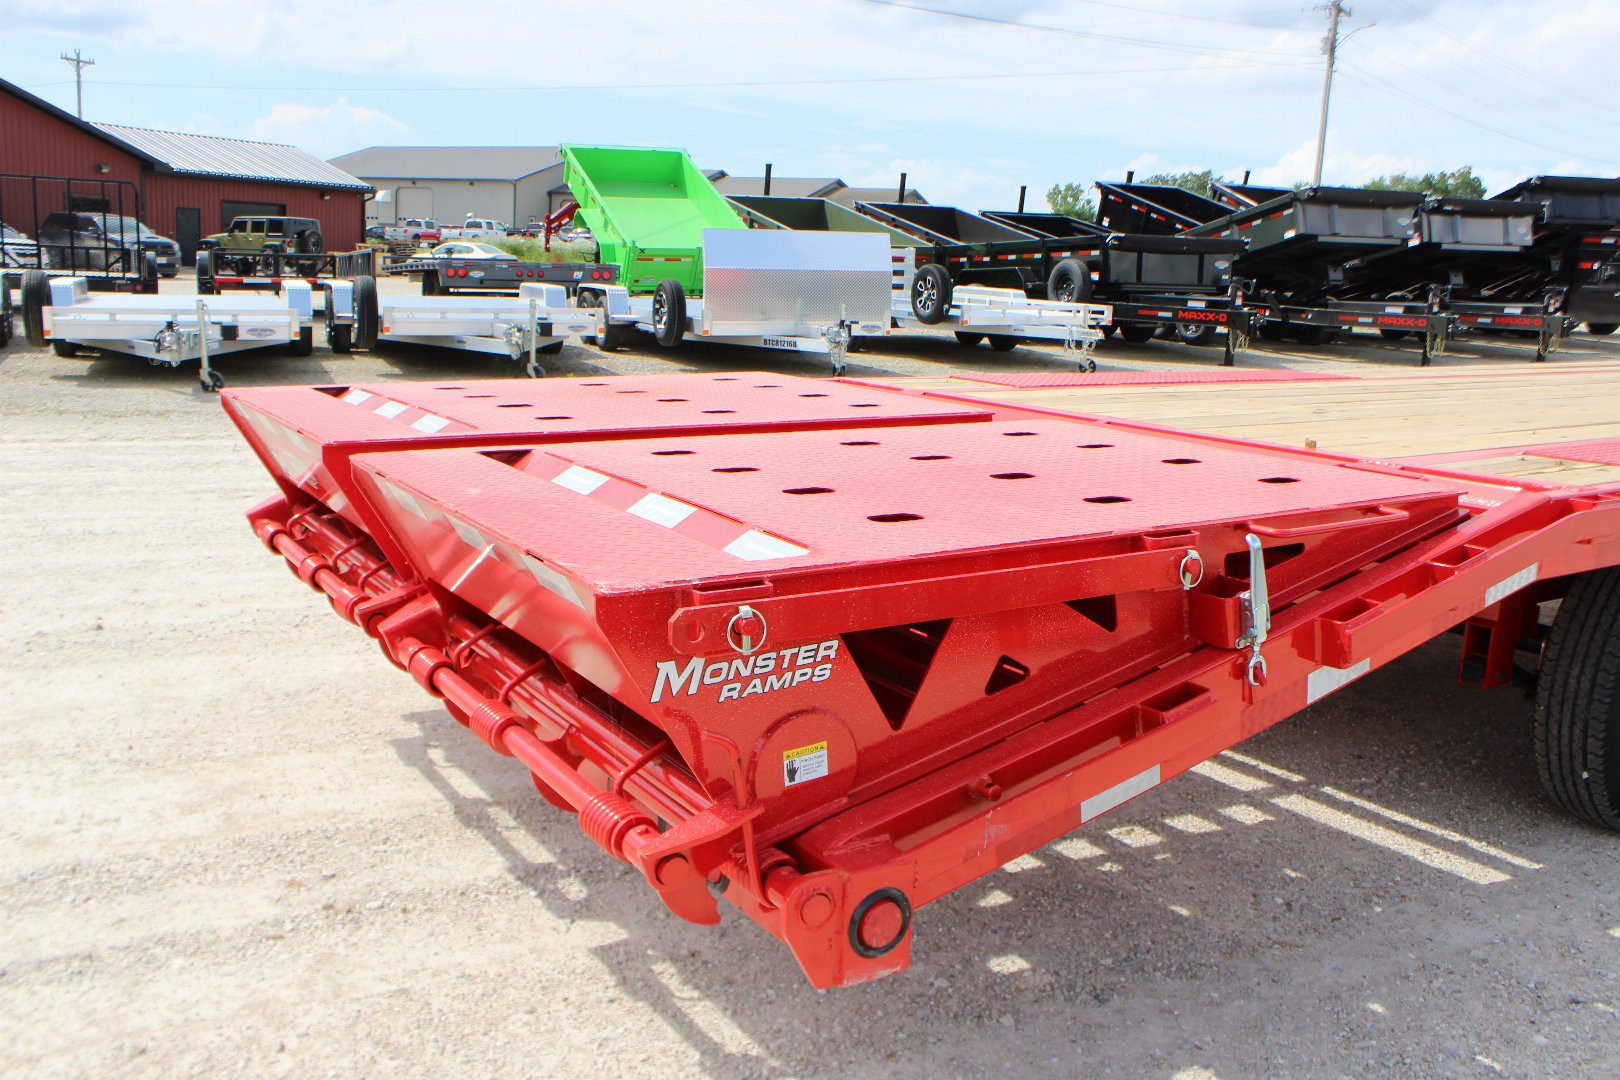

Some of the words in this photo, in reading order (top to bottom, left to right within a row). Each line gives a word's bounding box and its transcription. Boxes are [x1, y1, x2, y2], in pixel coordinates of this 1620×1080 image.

[1178, 310, 1228, 322] MAXX-D
[1377, 316, 1427, 327] MAXX-D
[1494, 316, 1542, 327] MAXX-D
[649, 639, 839, 704] MONSTER
[717, 663, 832, 703] RAMPS
[792, 745, 819, 758] CAUTION
